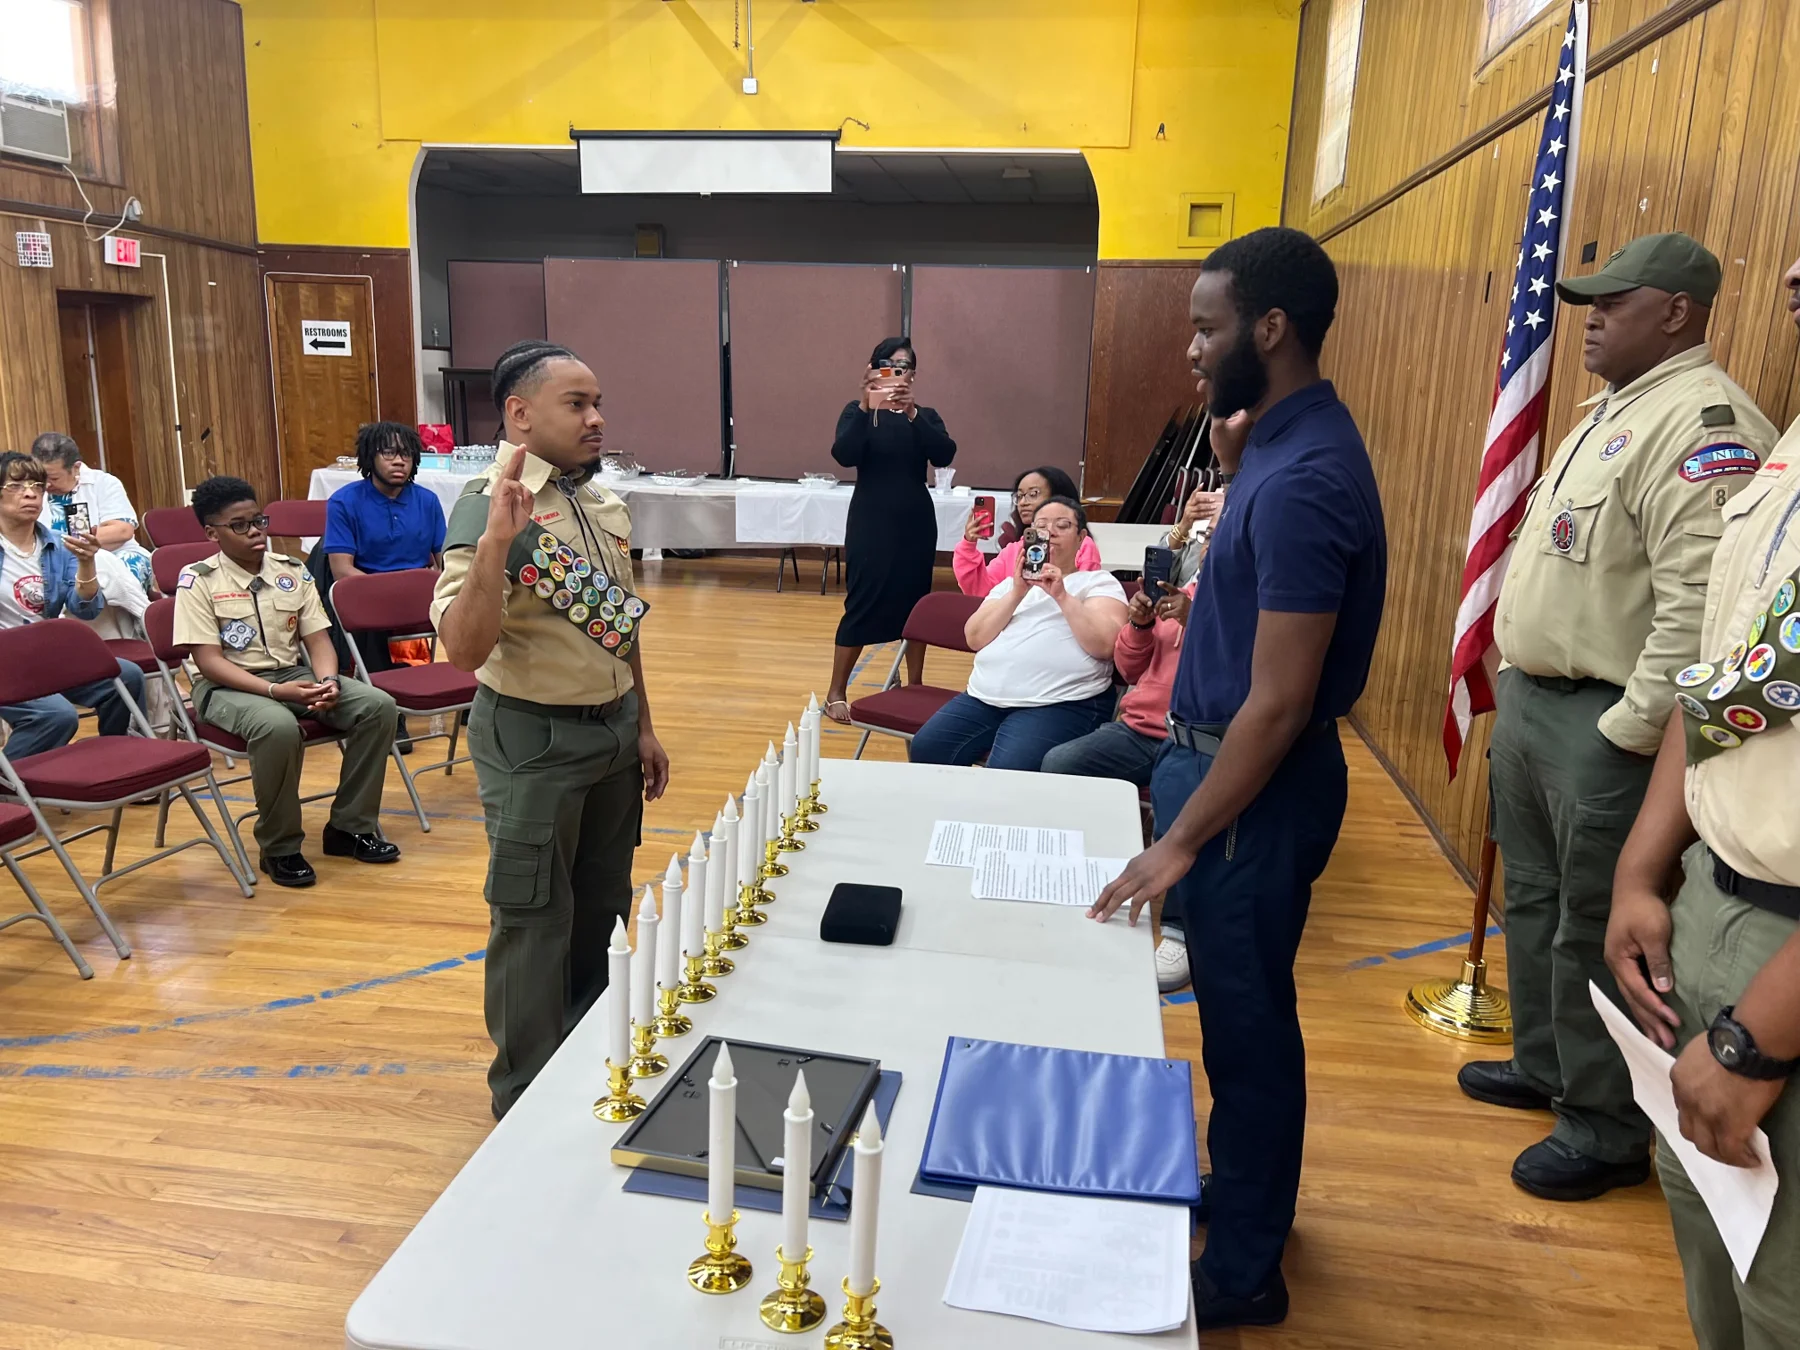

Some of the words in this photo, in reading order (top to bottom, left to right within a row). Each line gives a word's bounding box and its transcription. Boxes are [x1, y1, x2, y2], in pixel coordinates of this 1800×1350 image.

[117, 239, 137, 264] EXIT
[304, 327, 348, 338] RESTROOMS
[1715, 488, 1727, 507] 8
